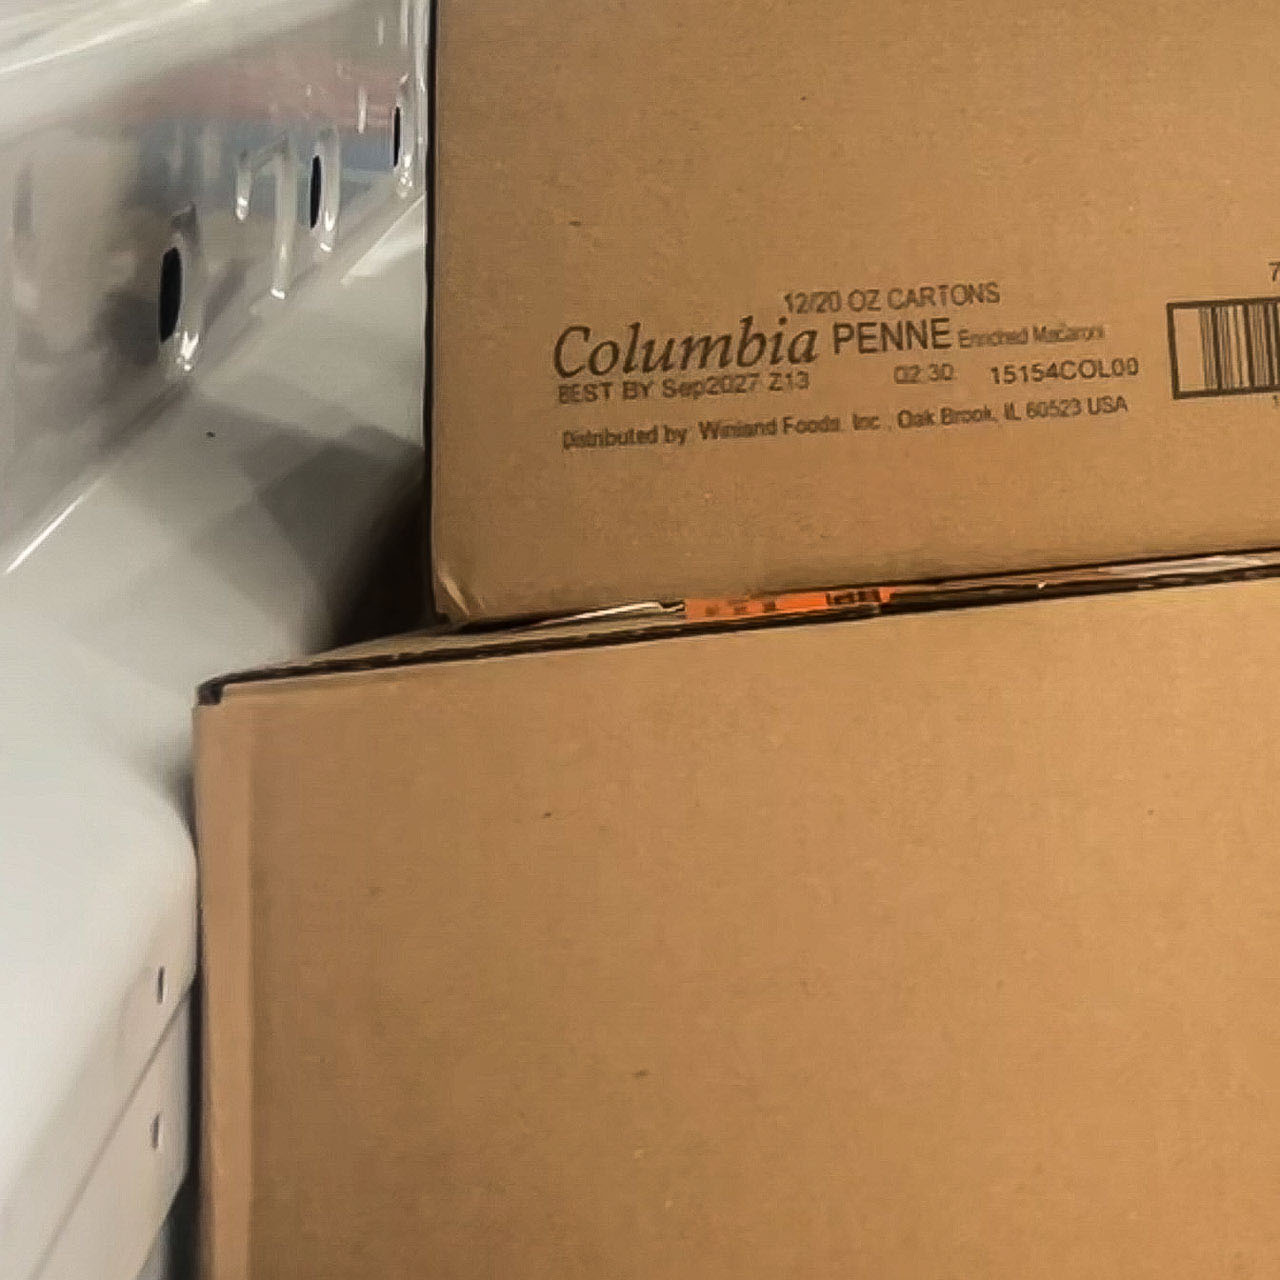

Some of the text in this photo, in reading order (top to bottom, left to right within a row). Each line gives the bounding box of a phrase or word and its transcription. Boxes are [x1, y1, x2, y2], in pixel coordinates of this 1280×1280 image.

[784, 281, 1001, 314] 12/20 OZ CARTONS
[553, 315, 820, 379] Columbia
[832, 317, 952, 355] PENNE
[557, 381, 613, 404] BEST
[622, 380, 655, 401] BY
[663, 424, 689, 446] by
[898, 408, 935, 429] Oak
[1004, 401, 1021, 420] IL
[1087, 394, 1129, 415] USA
